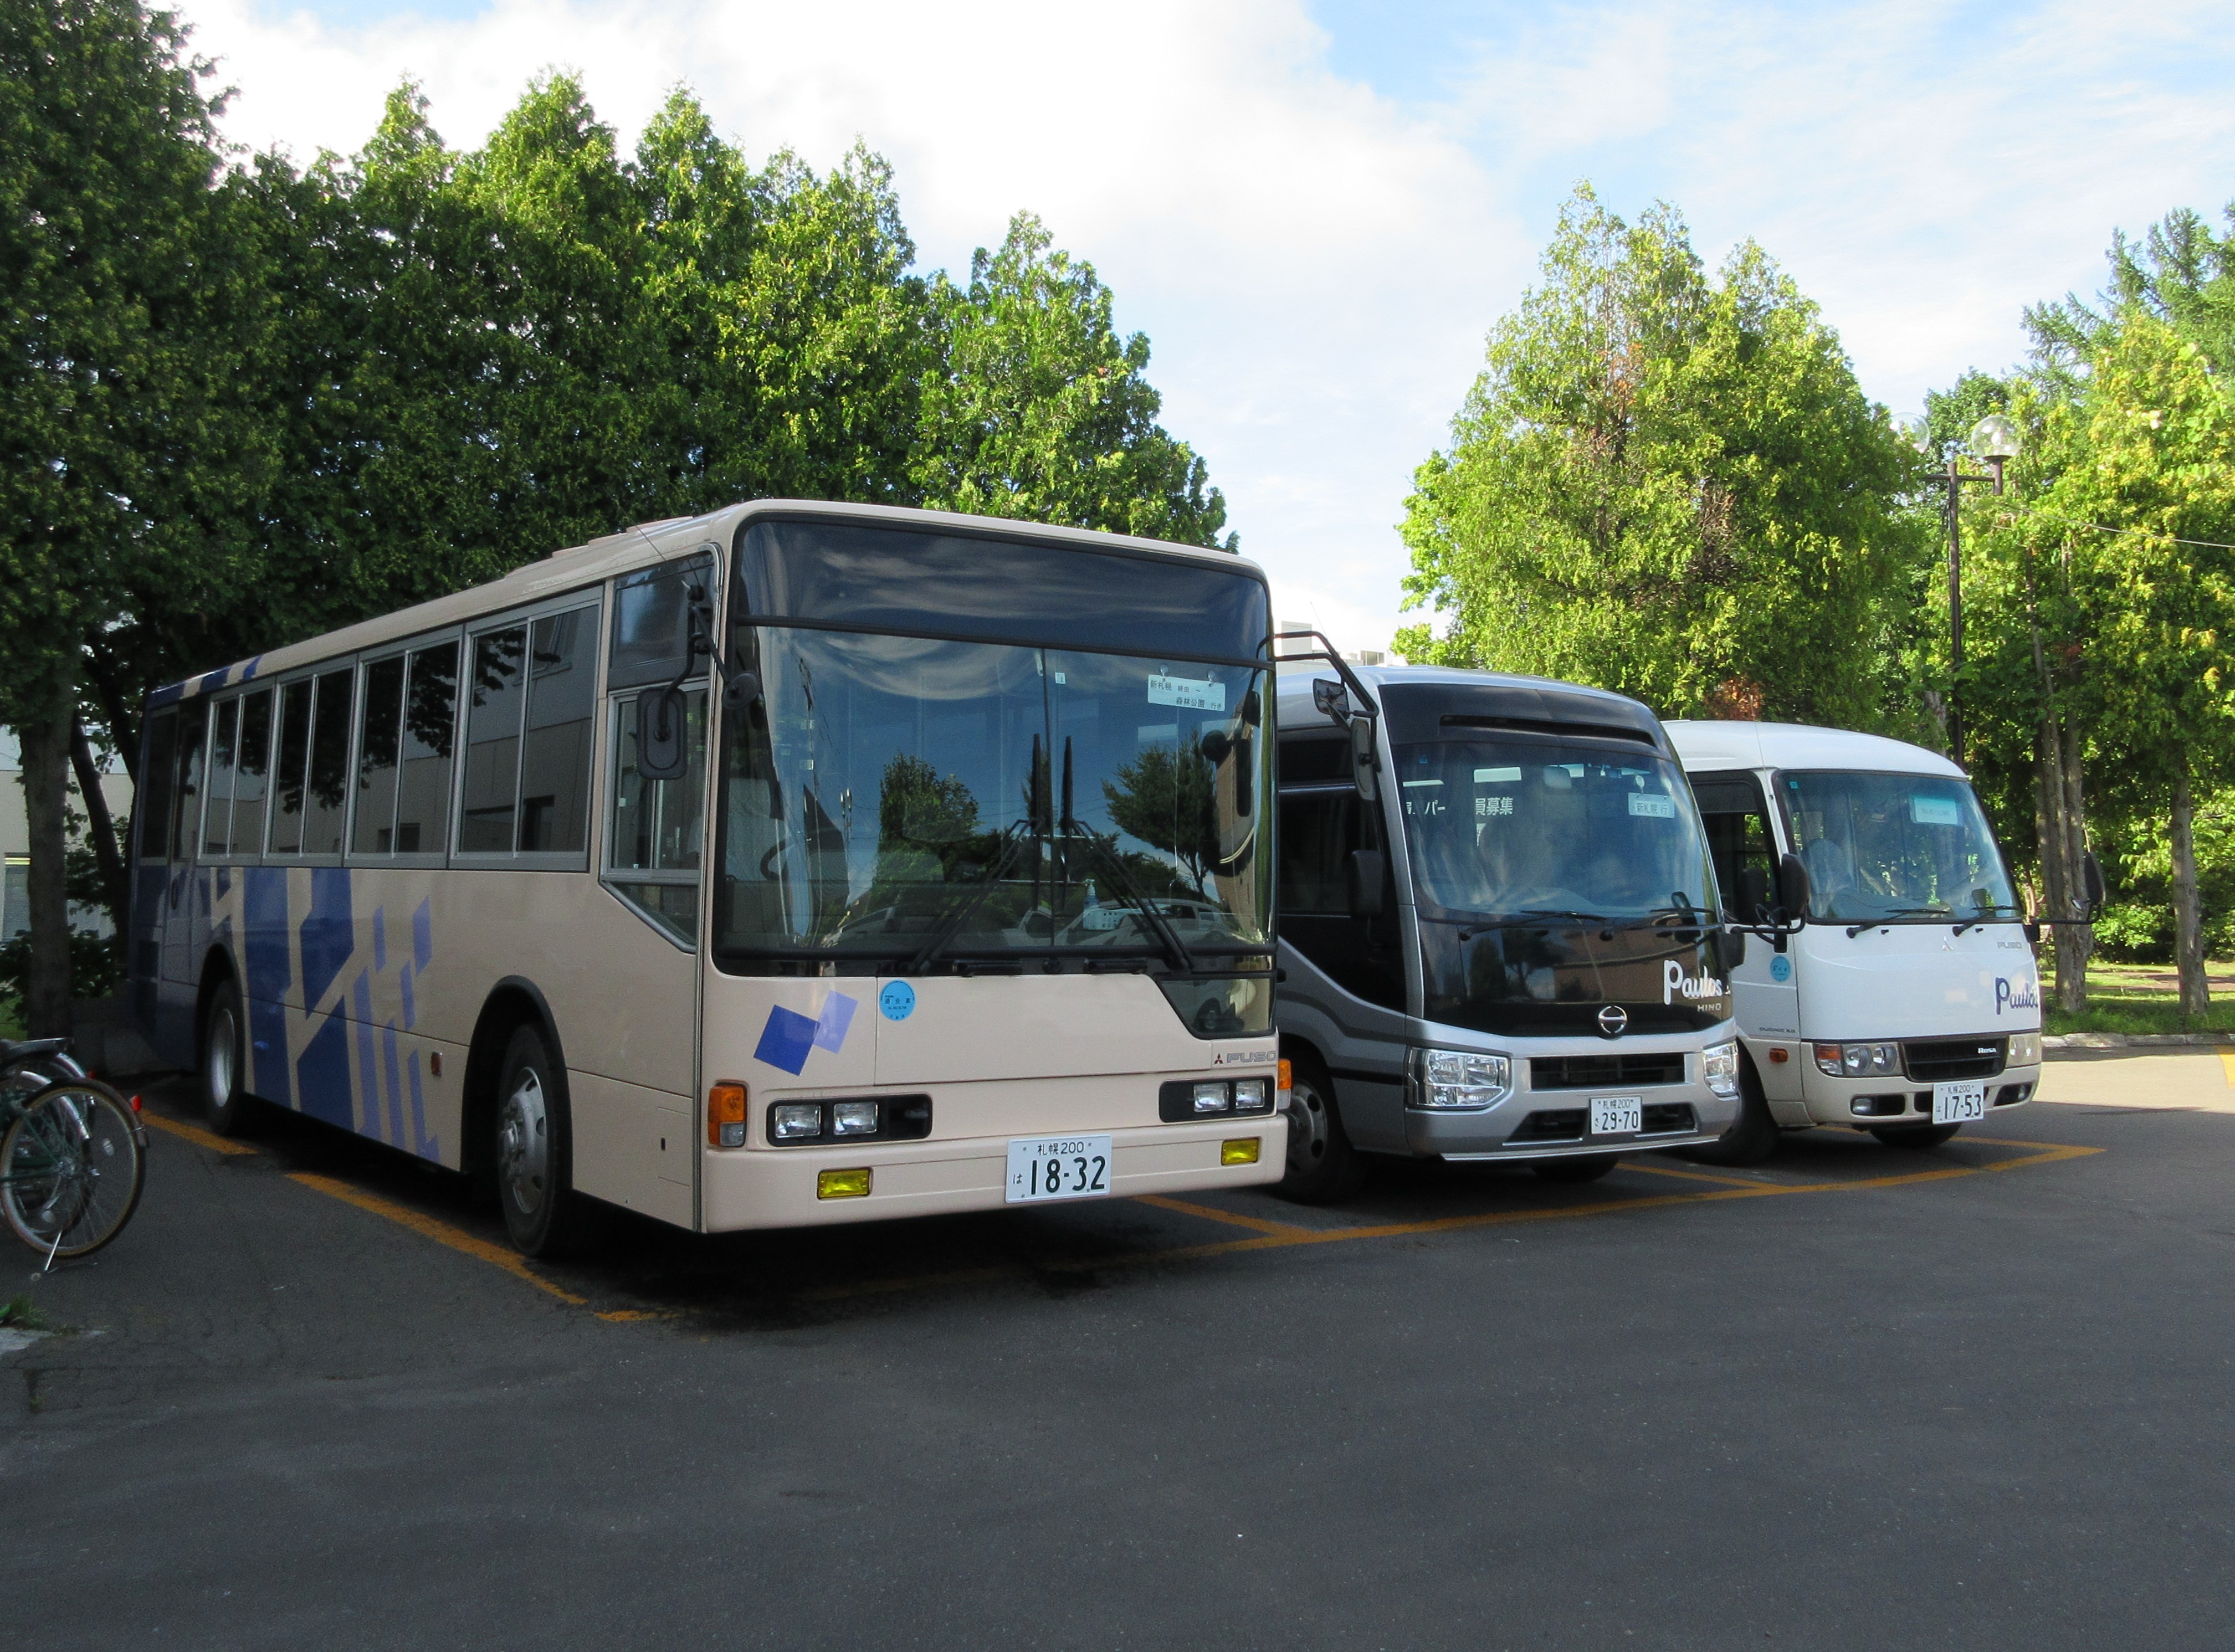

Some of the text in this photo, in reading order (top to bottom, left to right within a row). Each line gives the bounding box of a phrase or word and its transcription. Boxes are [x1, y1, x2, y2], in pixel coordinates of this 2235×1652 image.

[1176, 697, 1205, 708] 森林公園
[1697, 1003, 1722, 1012] HINO
[1227, 1051, 1277, 1063] FUSO
[1945, 1094, 1981, 1120] 17-53
[1602, 1111, 1638, 1131] 29-70
[1012, 1156, 1105, 1195] は 18-32
